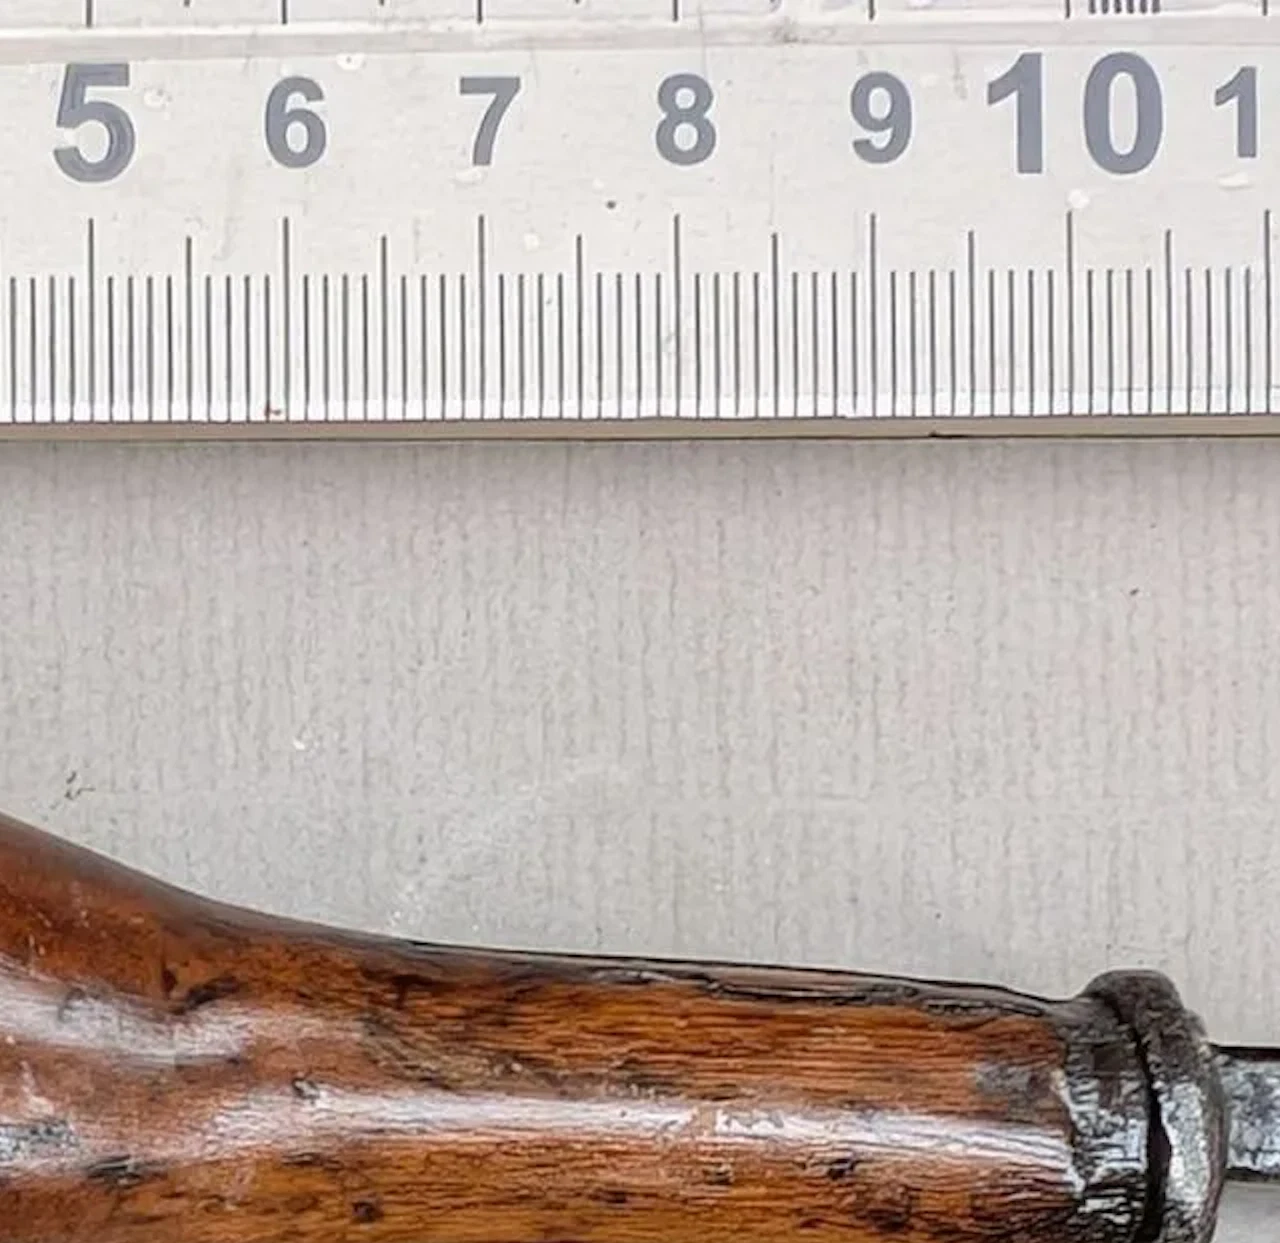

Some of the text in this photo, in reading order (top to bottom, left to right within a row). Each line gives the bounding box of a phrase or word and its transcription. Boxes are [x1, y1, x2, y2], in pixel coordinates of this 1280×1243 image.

[53, 63, 137, 183] 5
[264, 76, 327, 169] 6
[459, 76, 521, 167] 7
[655, 73, 717, 165] 8
[850, 71, 912, 164] 9
[987, 52, 1163, 175] 10
